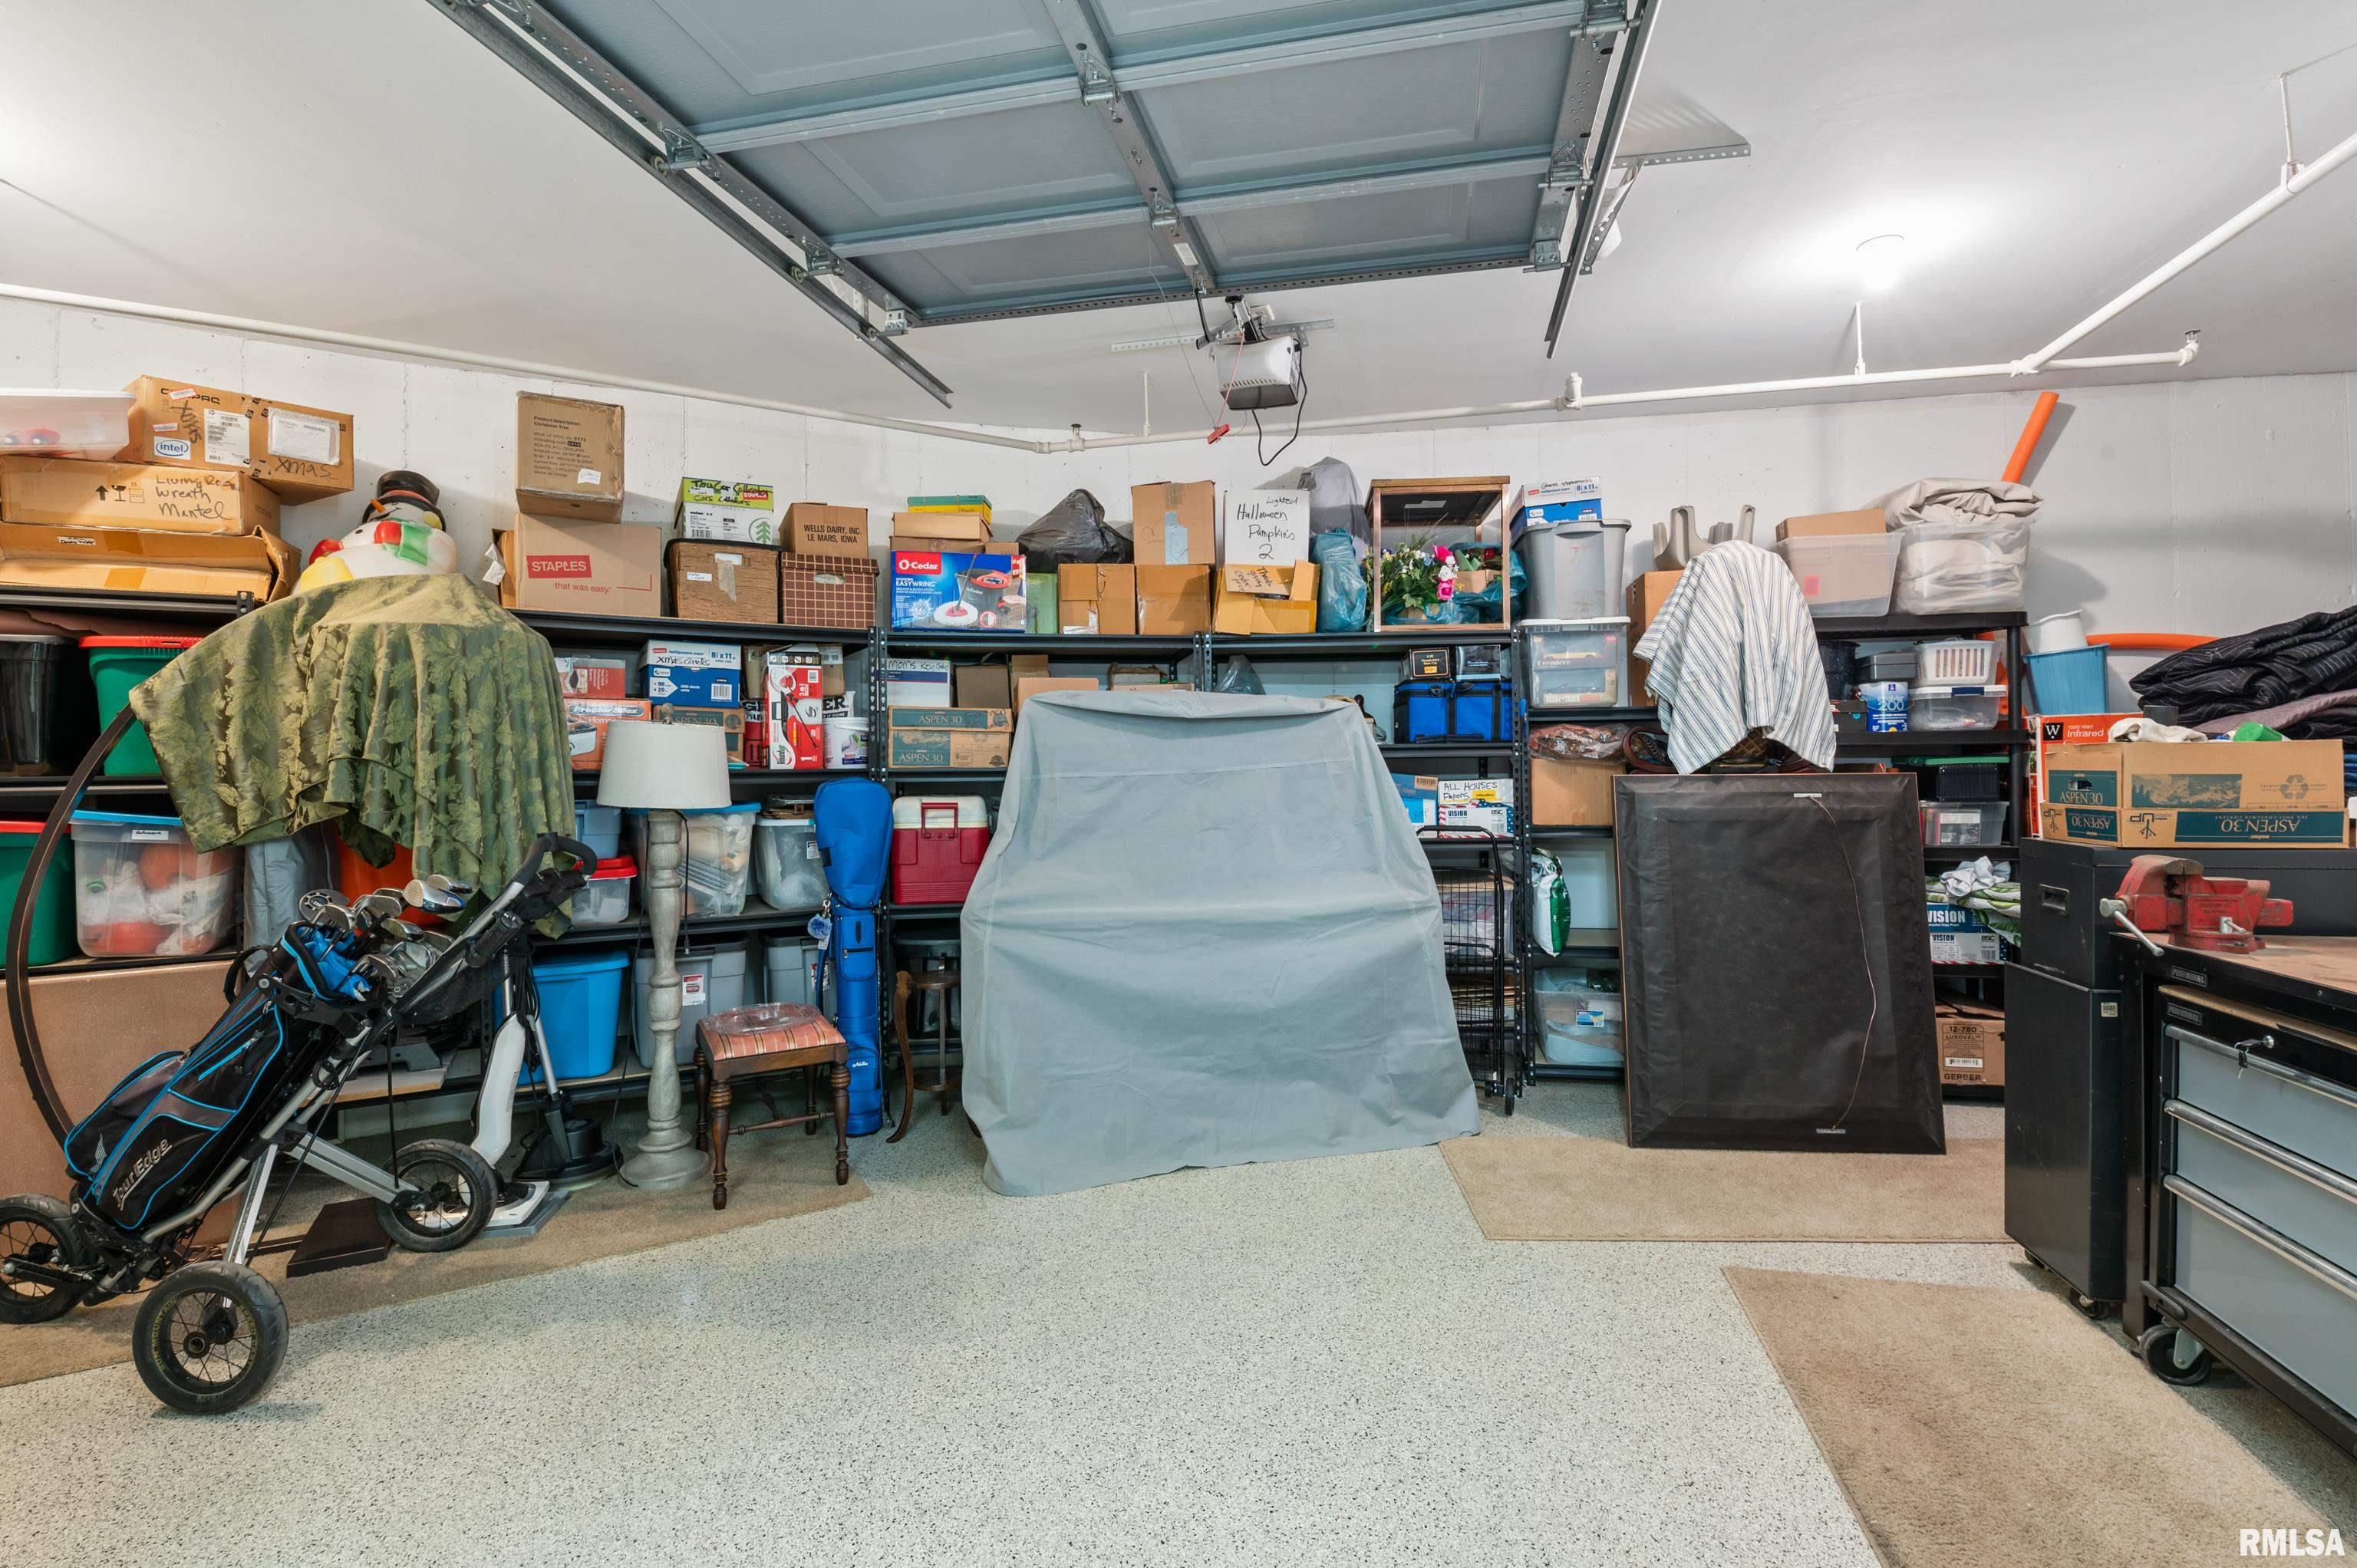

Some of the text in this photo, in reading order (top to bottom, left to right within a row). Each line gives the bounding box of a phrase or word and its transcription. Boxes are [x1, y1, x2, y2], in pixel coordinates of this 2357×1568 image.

[160, 387, 221, 405] CPAQ
[159, 442, 184, 454] intel
[1266, 496, 1298, 507] Lighted
[1237, 503, 1288, 521] Halloween
[804, 524, 825, 532] WELLS
[840, 535, 858, 543] IOWA
[1258, 543, 1274, 559] 2
[532, 561, 587, 572] STAPLES
[555, 582, 571, 591] that
[1878, 700, 1904, 711] 200
[918, 715, 963, 724] ASPEN 30
[2045, 725, 2061, 736] W
[2068, 729, 2104, 737] Infrared
[898, 754, 943, 763] ASPEN 30
[1444, 782, 1498, 791] ALL HOUSES
[2059, 791, 2103, 805] ASPEN 30
[2072, 815, 2111, 829] ASPEN 30
[2220, 819, 2301, 833] ASPEN 30
[1928, 910, 1966, 923] VISION
